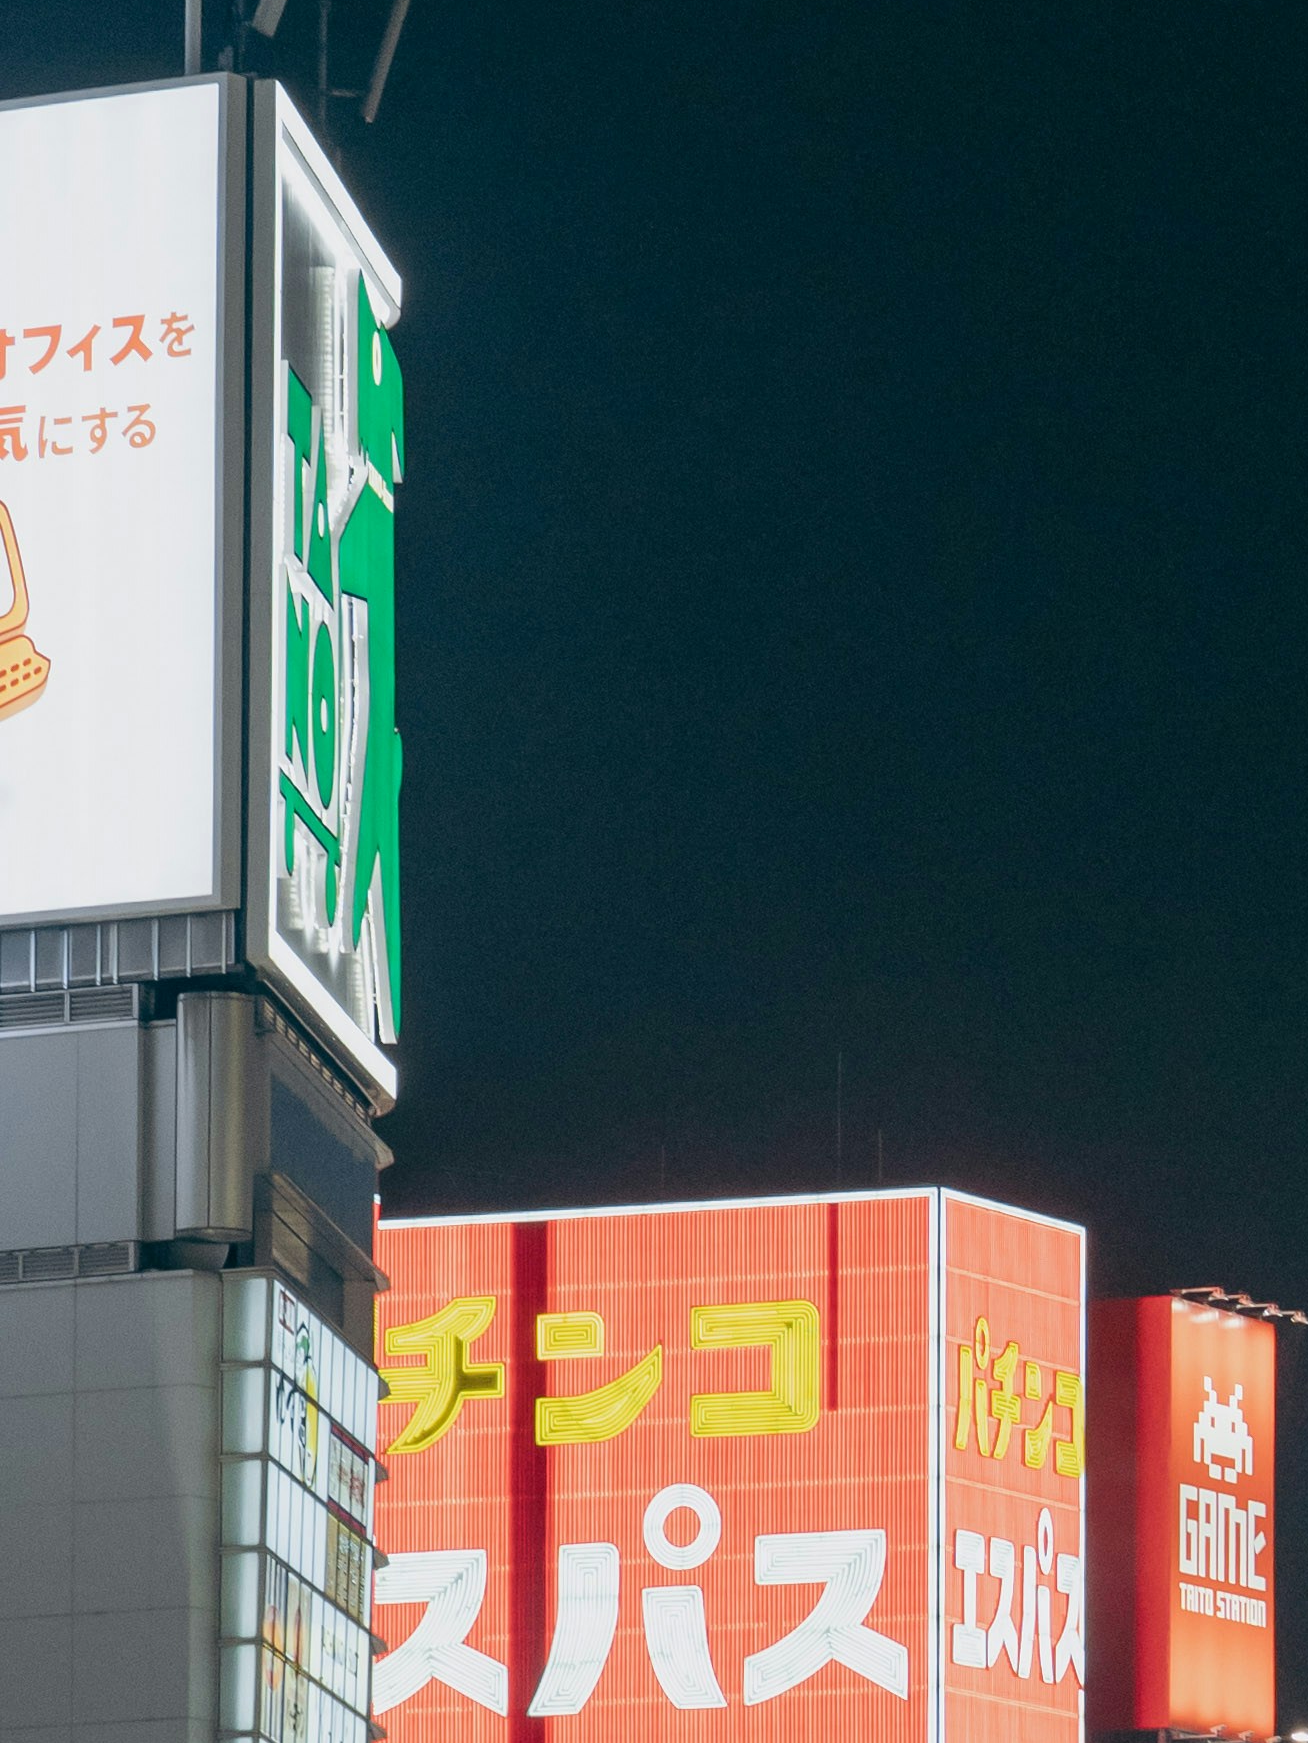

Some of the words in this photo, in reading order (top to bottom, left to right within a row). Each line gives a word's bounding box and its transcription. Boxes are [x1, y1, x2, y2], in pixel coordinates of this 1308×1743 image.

[376, 1295, 821, 1455] チンコ
[956, 1317, 1085, 1479] パチンコ
[954, 1506, 1085, 1685] エスパス
[1178, 1483, 1268, 1592] GAME
[1178, 1582, 1214, 1619] TAITO
[1215, 1591, 1267, 1629] STATION
